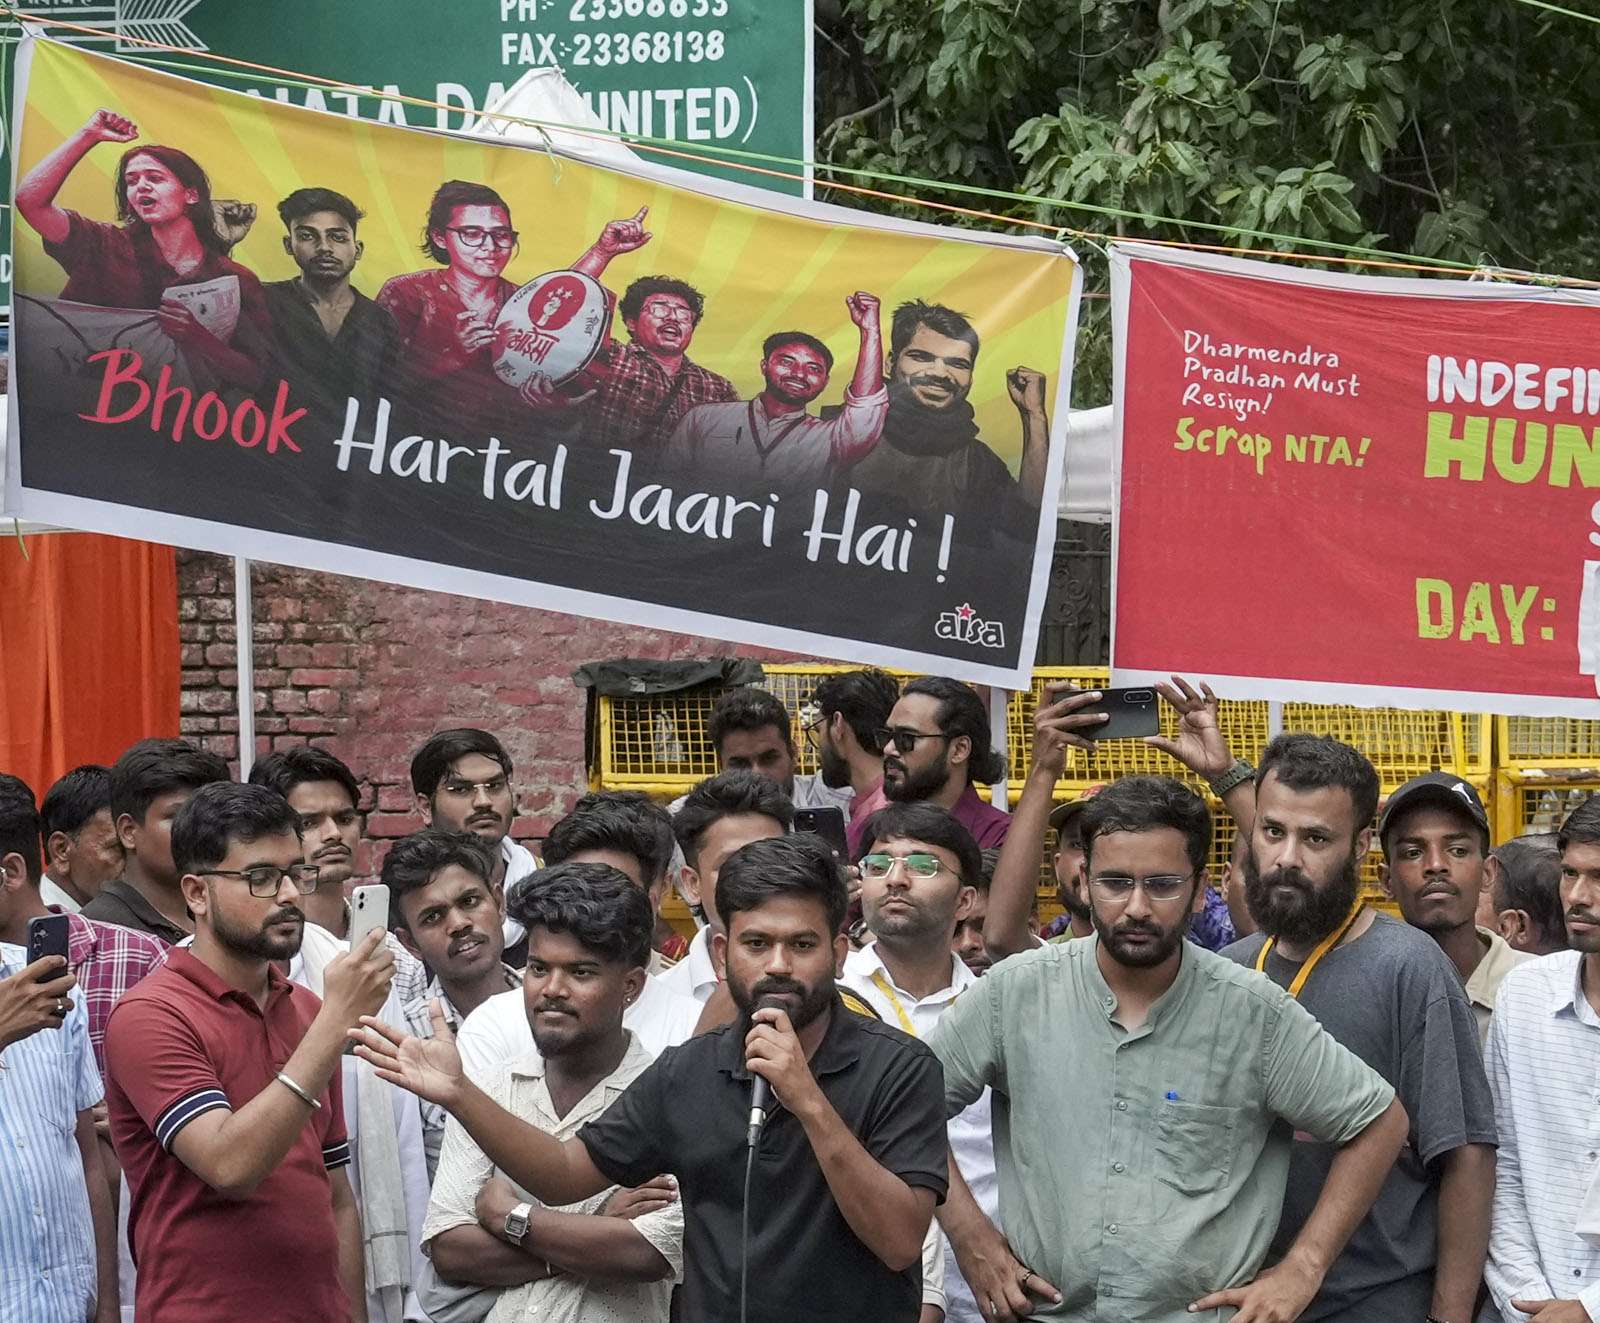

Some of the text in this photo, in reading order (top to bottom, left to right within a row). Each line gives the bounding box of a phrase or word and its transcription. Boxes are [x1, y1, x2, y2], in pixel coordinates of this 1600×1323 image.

[1183, 329, 1340, 368] Dharmendra
[1183, 356, 1361, 397] Pradhan Must
[1182, 382, 1273, 422] Resign!
[77, 347, 308, 457] Bhook
[332, 396, 569, 513] Hartal
[588, 447, 781, 550] Jaari
[801, 487, 919, 576] Hai
[1173, 416, 1372, 476] Scrap NTA!
[935, 603, 1005, 648] aisa
[1415, 577, 1556, 645] DAY:
